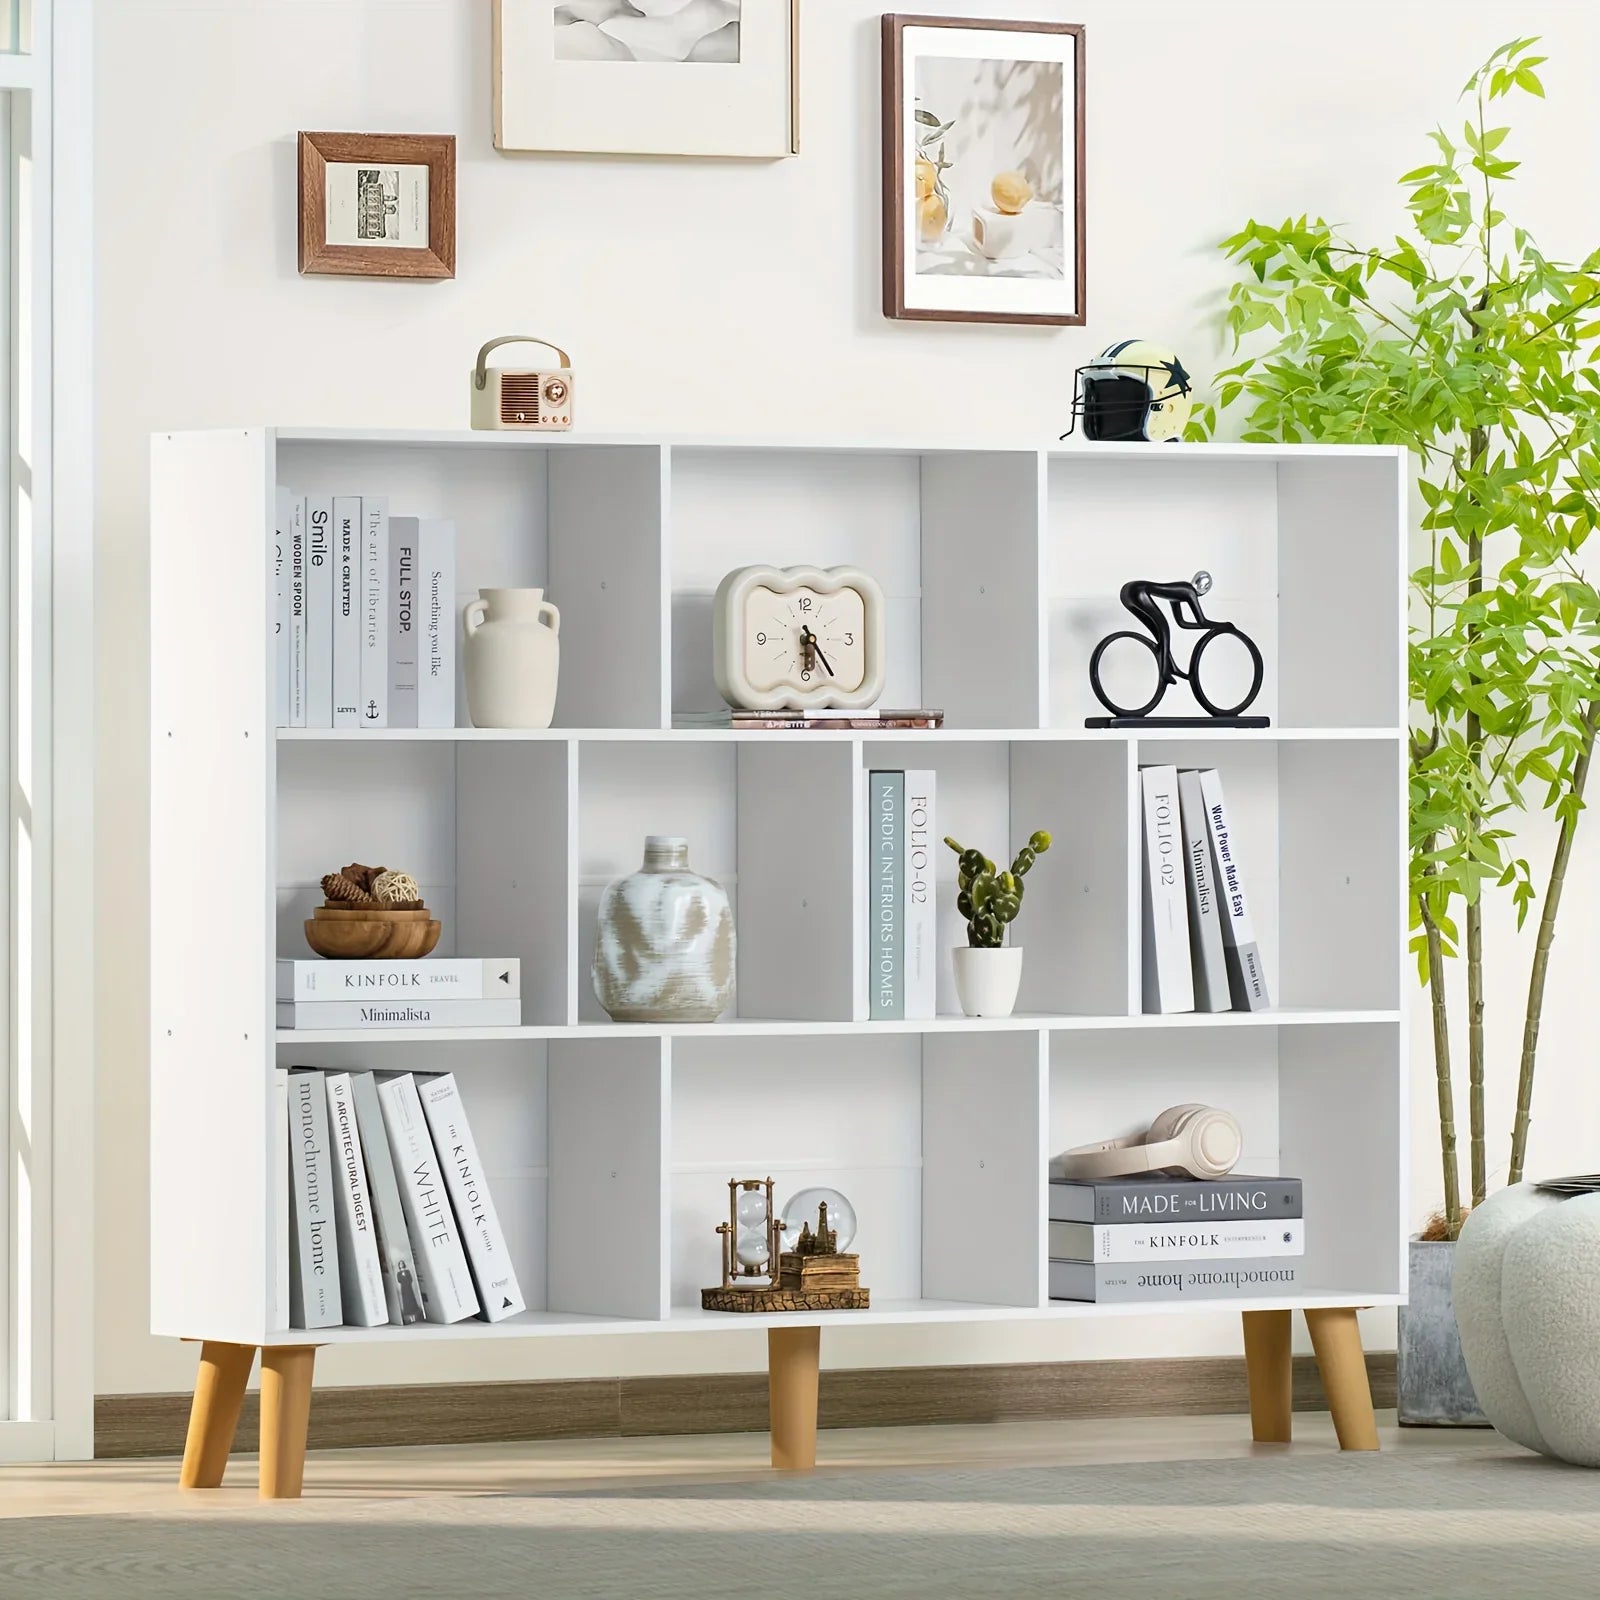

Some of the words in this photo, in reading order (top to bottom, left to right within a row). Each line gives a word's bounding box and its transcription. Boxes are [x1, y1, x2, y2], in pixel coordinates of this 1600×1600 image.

[342, 518, 351, 553] MADE
[369, 510, 381, 537] The
[312, 510, 328, 567] Smile
[369, 542, 379, 562] art
[293, 534, 302, 579] WOODEN
[342, 554, 351, 563] &
[399, 547, 412, 587] FULL
[369, 568, 380, 584] of
[293, 581, 302, 617] SPOON
[342, 565, 351, 617] CRAFTED
[429, 571, 442, 631] Something
[798, 598, 812, 611] 12
[369, 587, 381, 648] libraries
[399, 590, 412, 634] STOP.
[429, 633, 439, 654] you
[756, 632, 767, 646] 9
[844, 632, 854, 646] 3
[430, 656, 442, 677] like
[801, 668, 810, 681] 6
[881, 784, 894, 849] NORDIC
[1210, 804, 1225, 831] Word
[911, 796, 928, 904] FOLIO-02
[1154, 794, 1175, 886] FOLIO-02
[1217, 831, 1231, 863] Power
[1191, 839, 1210, 915] Minimalista
[1226, 865, 1239, 892] Made
[881, 856, 894, 943] INTERIORS
[1232, 892, 1244, 917] Easy
[881, 947, 894, 1008] HOMES
[1247, 952, 1257, 979] Norman
[345, 973, 421, 988] KINFOLK
[429, 974, 459, 984] TRAVEL
[1251, 978, 1262, 998] Lewis
[360, 1007, 431, 1022] Minimalista
[299, 1082, 320, 1214] monochrome
[310, 1219, 326, 1276] home
[336, 1100, 360, 1192] ARCHITECTURAL
[352, 1192, 367, 1233] DIGEST
[453, 1144, 486, 1227] KINFOLK
[413, 1161, 450, 1248] WHITE
[1122, 1194, 1180, 1215] MADE
[1184, 1199, 1197, 1207] FOR
[1199, 1191, 1268, 1212] LIVING
[1149, 1234, 1220, 1248] KINFOLK
[1137, 1274, 1183, 1292] home
[1188, 1269, 1295, 1289] monochrome
